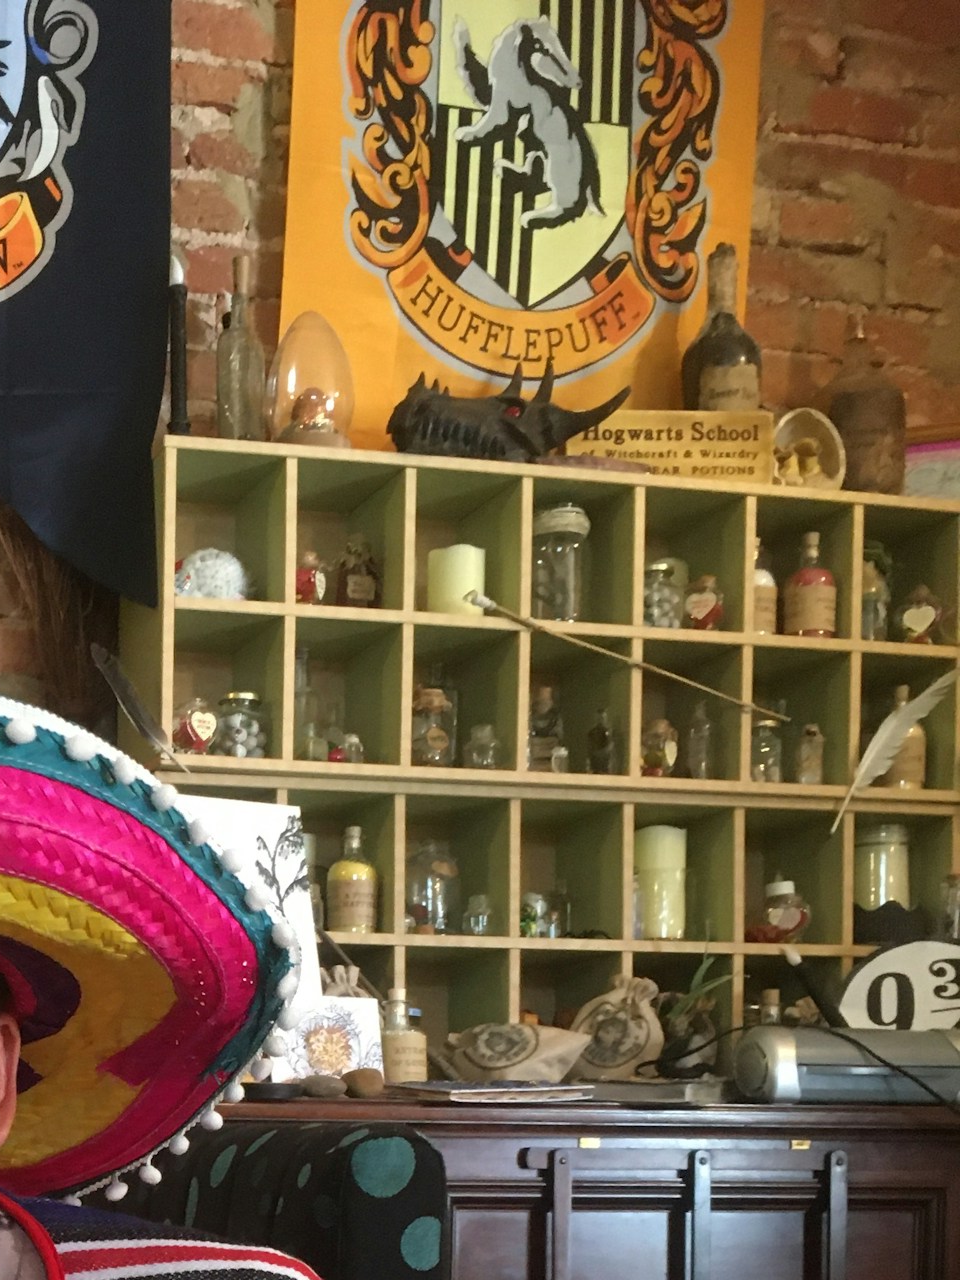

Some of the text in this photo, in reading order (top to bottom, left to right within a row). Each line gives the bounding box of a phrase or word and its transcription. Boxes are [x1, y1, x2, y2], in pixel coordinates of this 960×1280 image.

[409, 274, 628, 363] HUFFLEPUFF
[582, 421, 759, 446] Hogwarts School
[605, 449, 678, 458] Witchcraft
[700, 449, 759, 461] Wizardry
[692, 465, 755, 475] POTIONS
